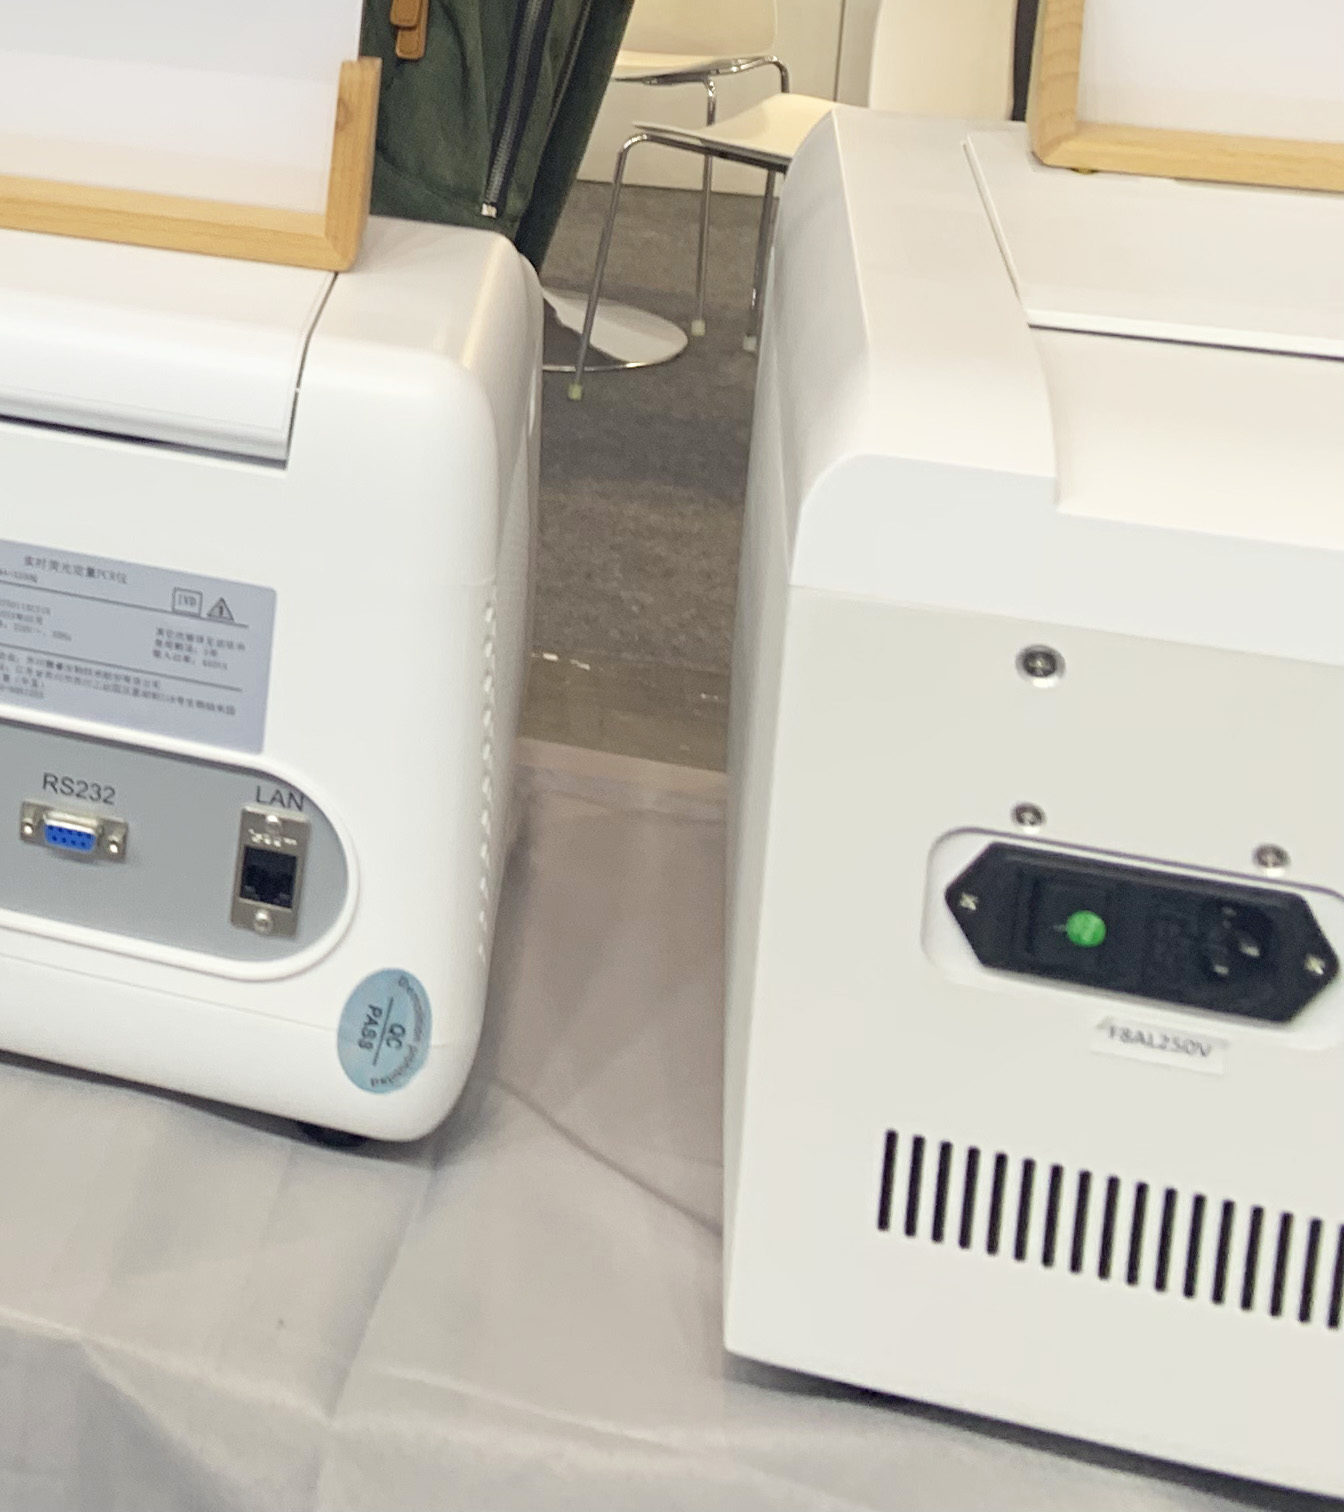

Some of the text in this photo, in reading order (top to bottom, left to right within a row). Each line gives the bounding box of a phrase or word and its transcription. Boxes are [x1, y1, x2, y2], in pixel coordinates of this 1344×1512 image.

[42, 771, 116, 806] RS232
[255, 785, 305, 811] LAN
[357, 1003, 383, 1050] PASS
[386, 1022, 406, 1050] QC
